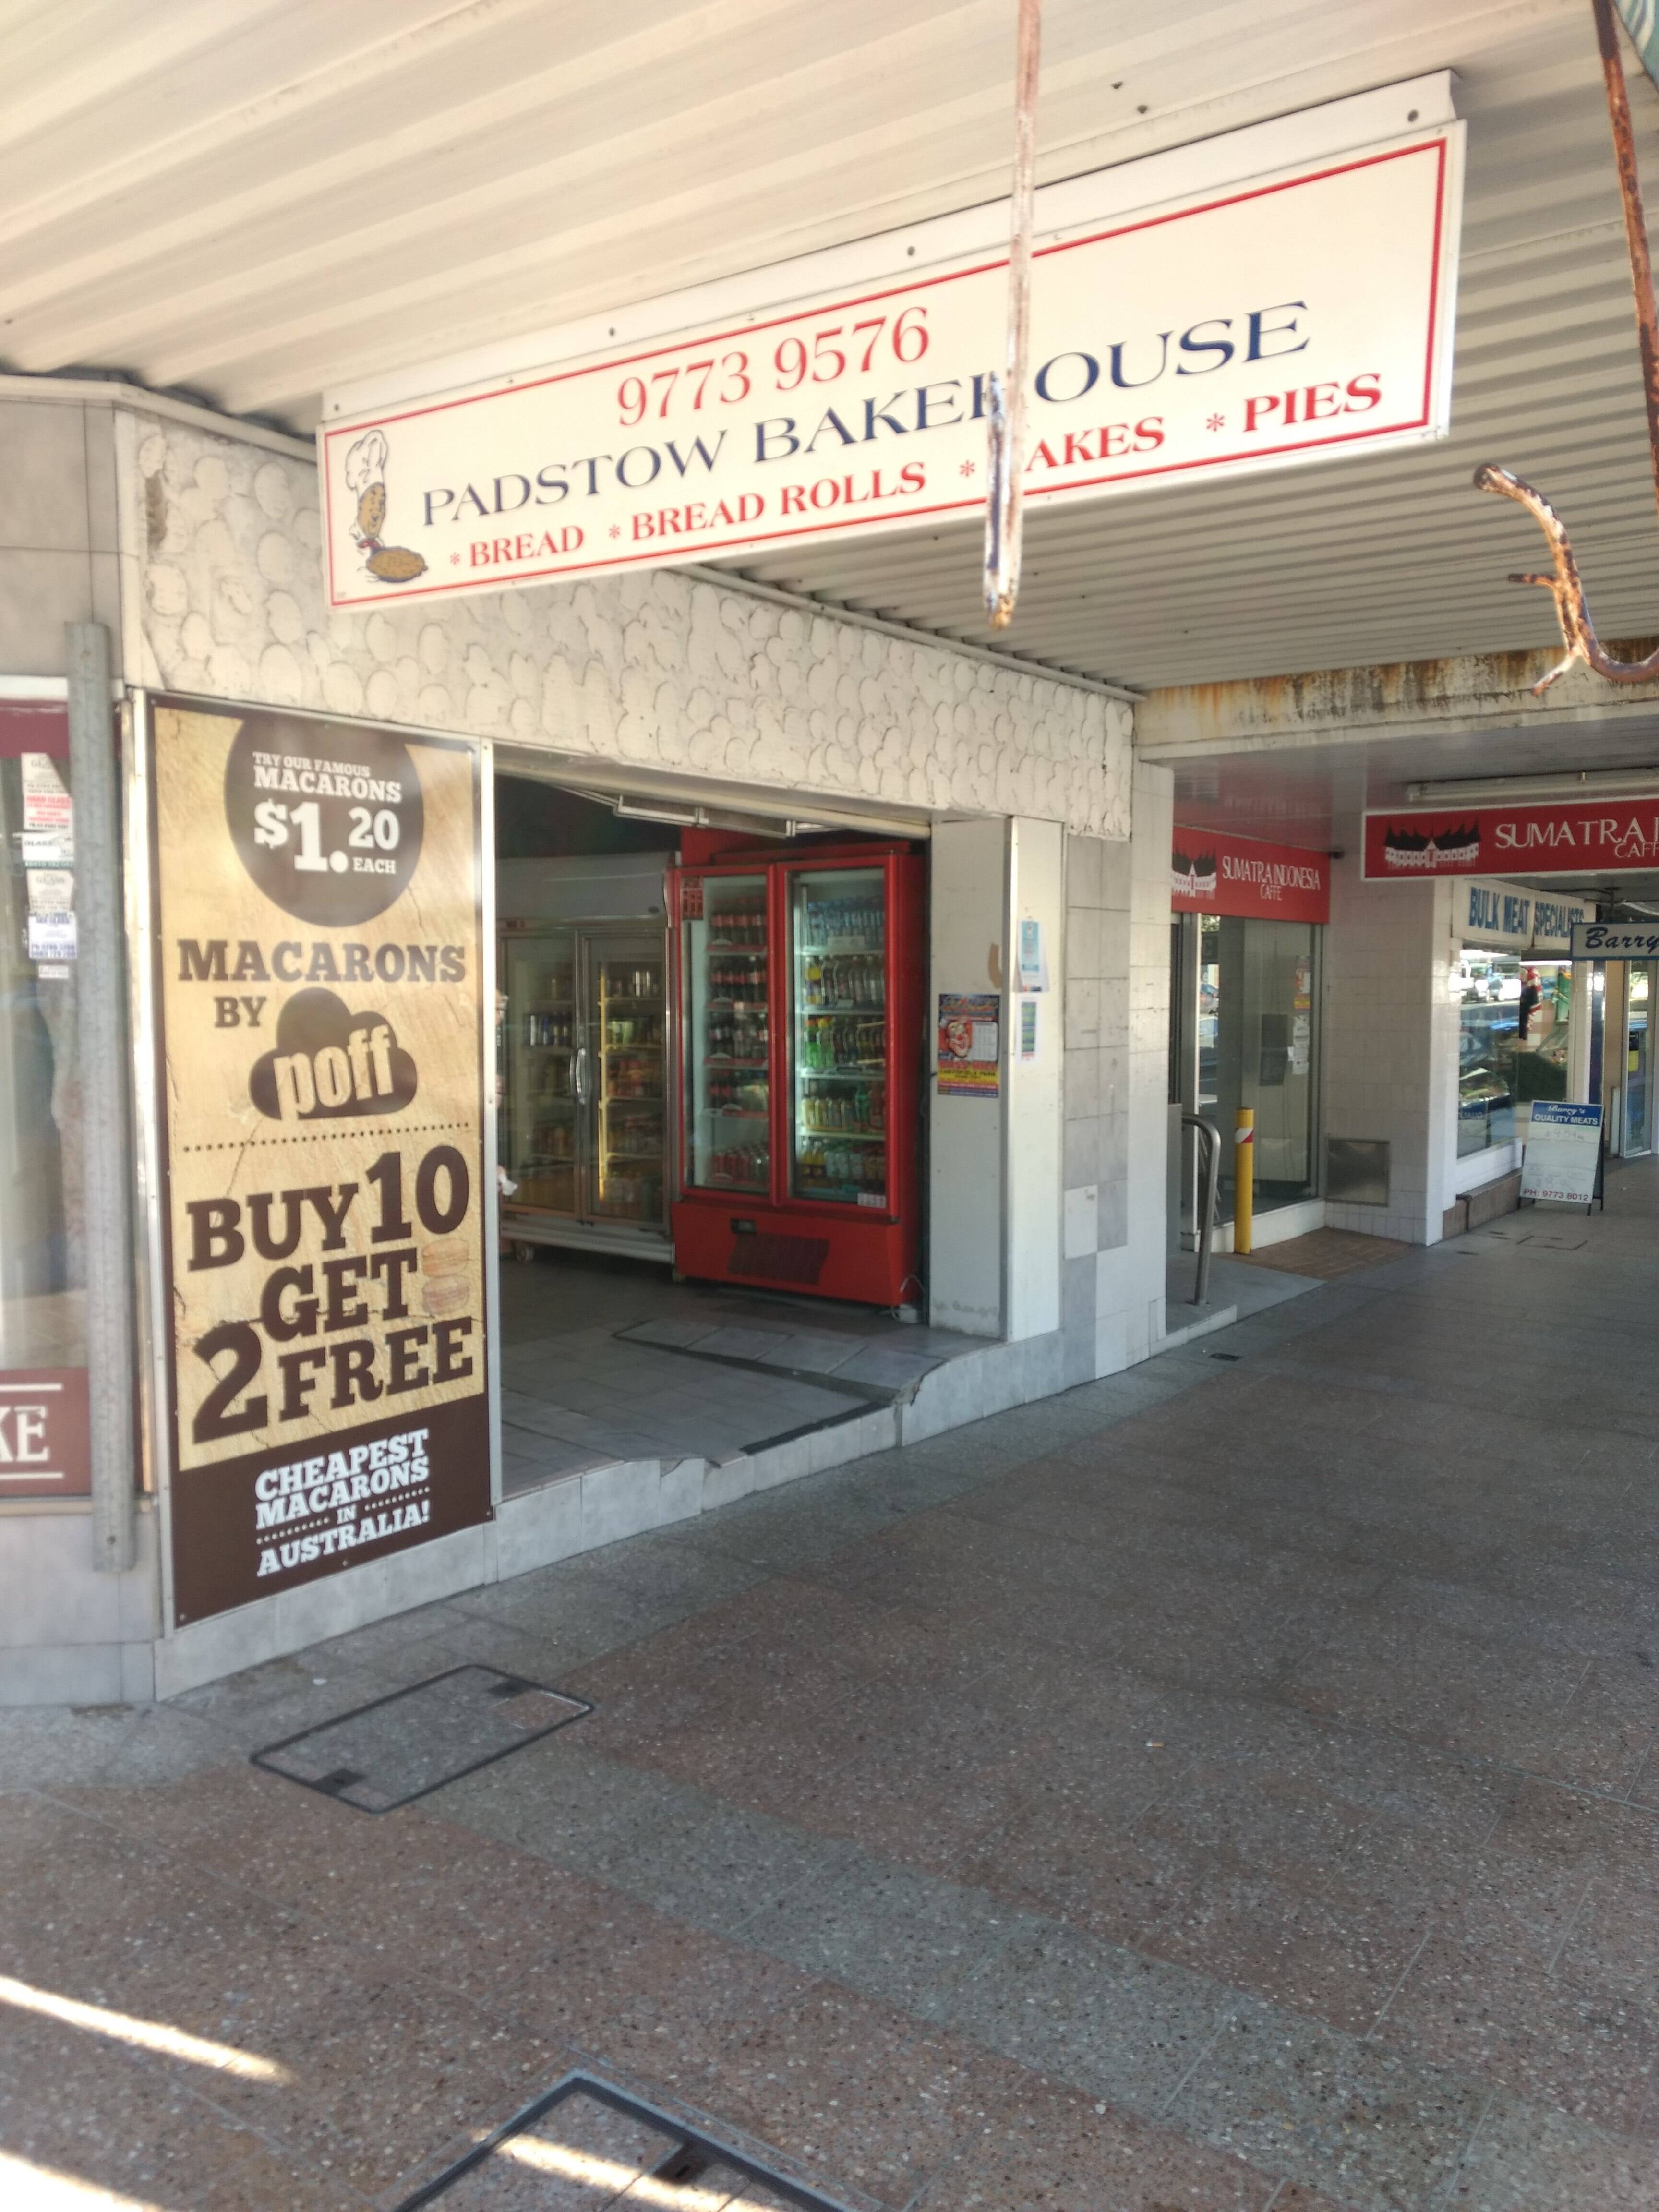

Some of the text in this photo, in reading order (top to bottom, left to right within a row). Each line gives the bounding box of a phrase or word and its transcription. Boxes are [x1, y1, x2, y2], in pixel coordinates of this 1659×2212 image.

[618, 306, 930, 428] 9773 9576
[422, 429, 729, 527] PADSTOW
[469, 373, 1382, 568] BREAD BREAD ROLLS AKES PIES
[252, 751, 372, 777] TRY OUR FAMOUS
[253, 767, 402, 804] MACARONS
[1495, 817, 1646, 848] SUMATRA
[352, 856, 396, 875] EACH
[1222, 856, 1321, 890] SUMATRA INDONESIA
[1260, 884, 1282, 901] CAFFE
[1469, 887, 1500, 930] BULK
[1503, 895, 1530, 935] MEAT
[177, 939, 466, 983] MACARONS
[1586, 926, 1659, 953] Barry
[214, 996, 267, 1029] BY
[273, 1024, 395, 1121] poff
[1535, 1114, 1598, 1125] QUALITY MEATS
[186, 1145, 470, 1272] BUY 10
[1566, 1193, 1588, 1201] 8012
[260, 1247, 417, 1343] GET
[192, 1316, 474, 1445] 2 FREE
[255, 1428, 430, 1502] CHEAPEST
[256, 1457, 430, 1529] MACARONS
[337, 1504, 357, 1524] IN
[257, 1501, 431, 1577] AUSTRALIA!
